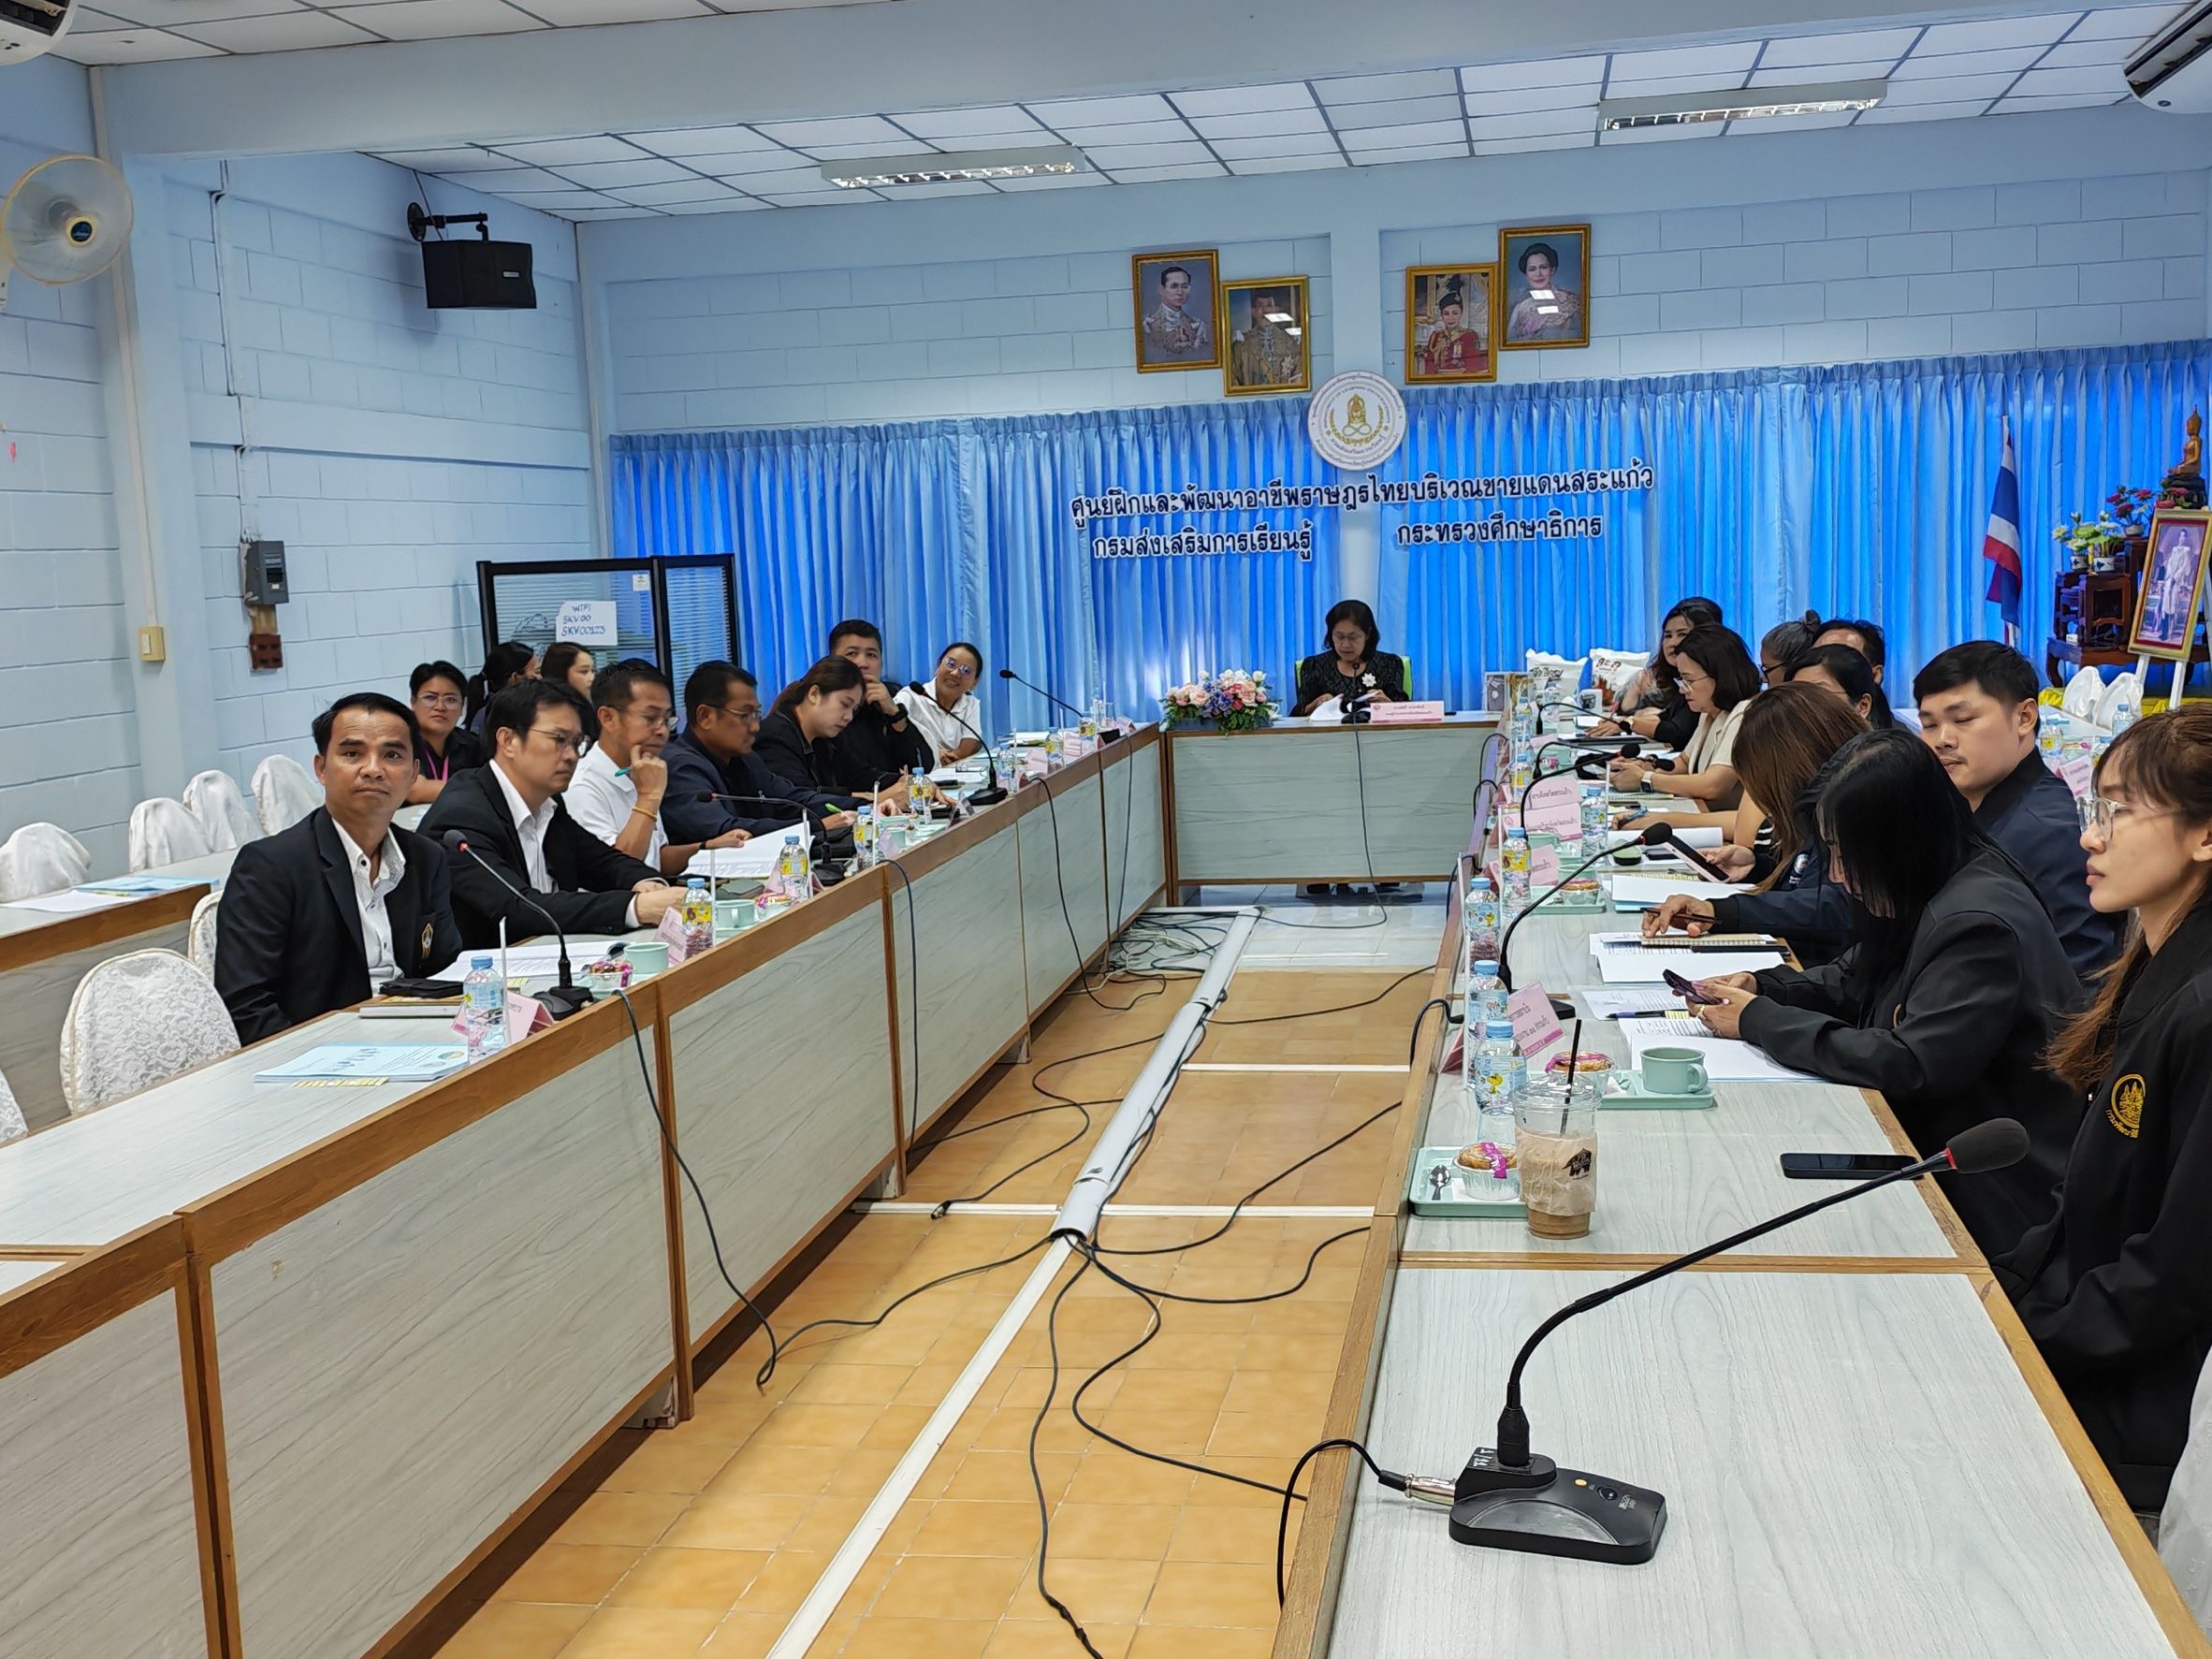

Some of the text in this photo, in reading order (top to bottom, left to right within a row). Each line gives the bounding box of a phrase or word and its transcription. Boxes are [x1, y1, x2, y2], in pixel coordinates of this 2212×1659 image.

[1094, 519, 1312, 560] กรมส่งเสริมการเรียนรู้
[1397, 509, 1602, 545] กระทรวงศึกษาธิการ
